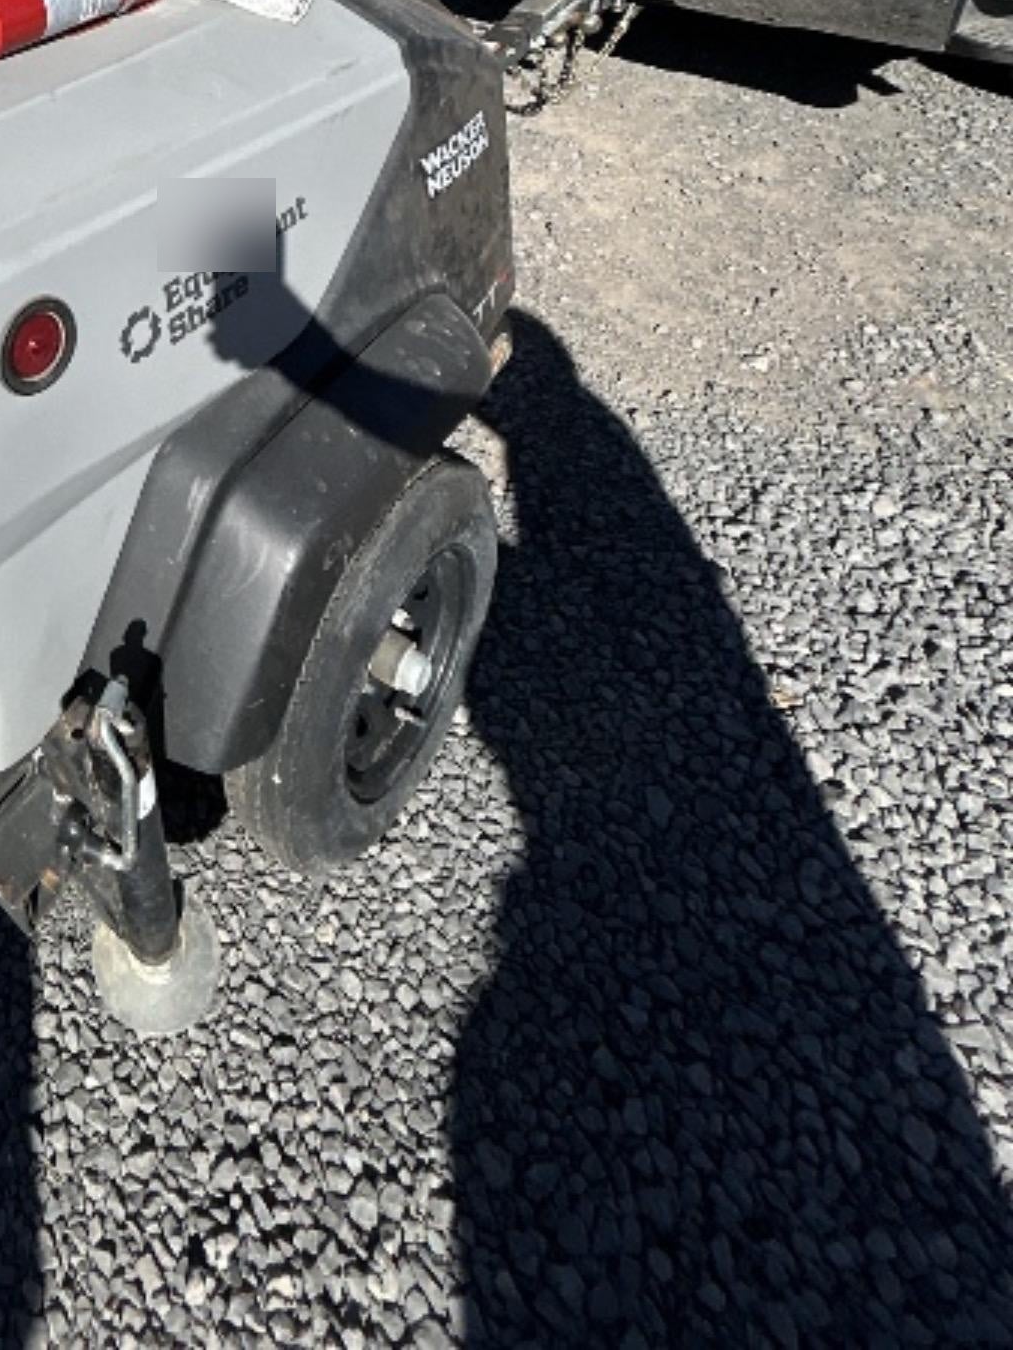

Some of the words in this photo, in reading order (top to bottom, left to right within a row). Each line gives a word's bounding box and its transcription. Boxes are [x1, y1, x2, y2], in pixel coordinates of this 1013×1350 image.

[420, 110, 486, 175] WACKER
[426, 134, 489, 199] NEUSON
[168, 275, 250, 345] Share
